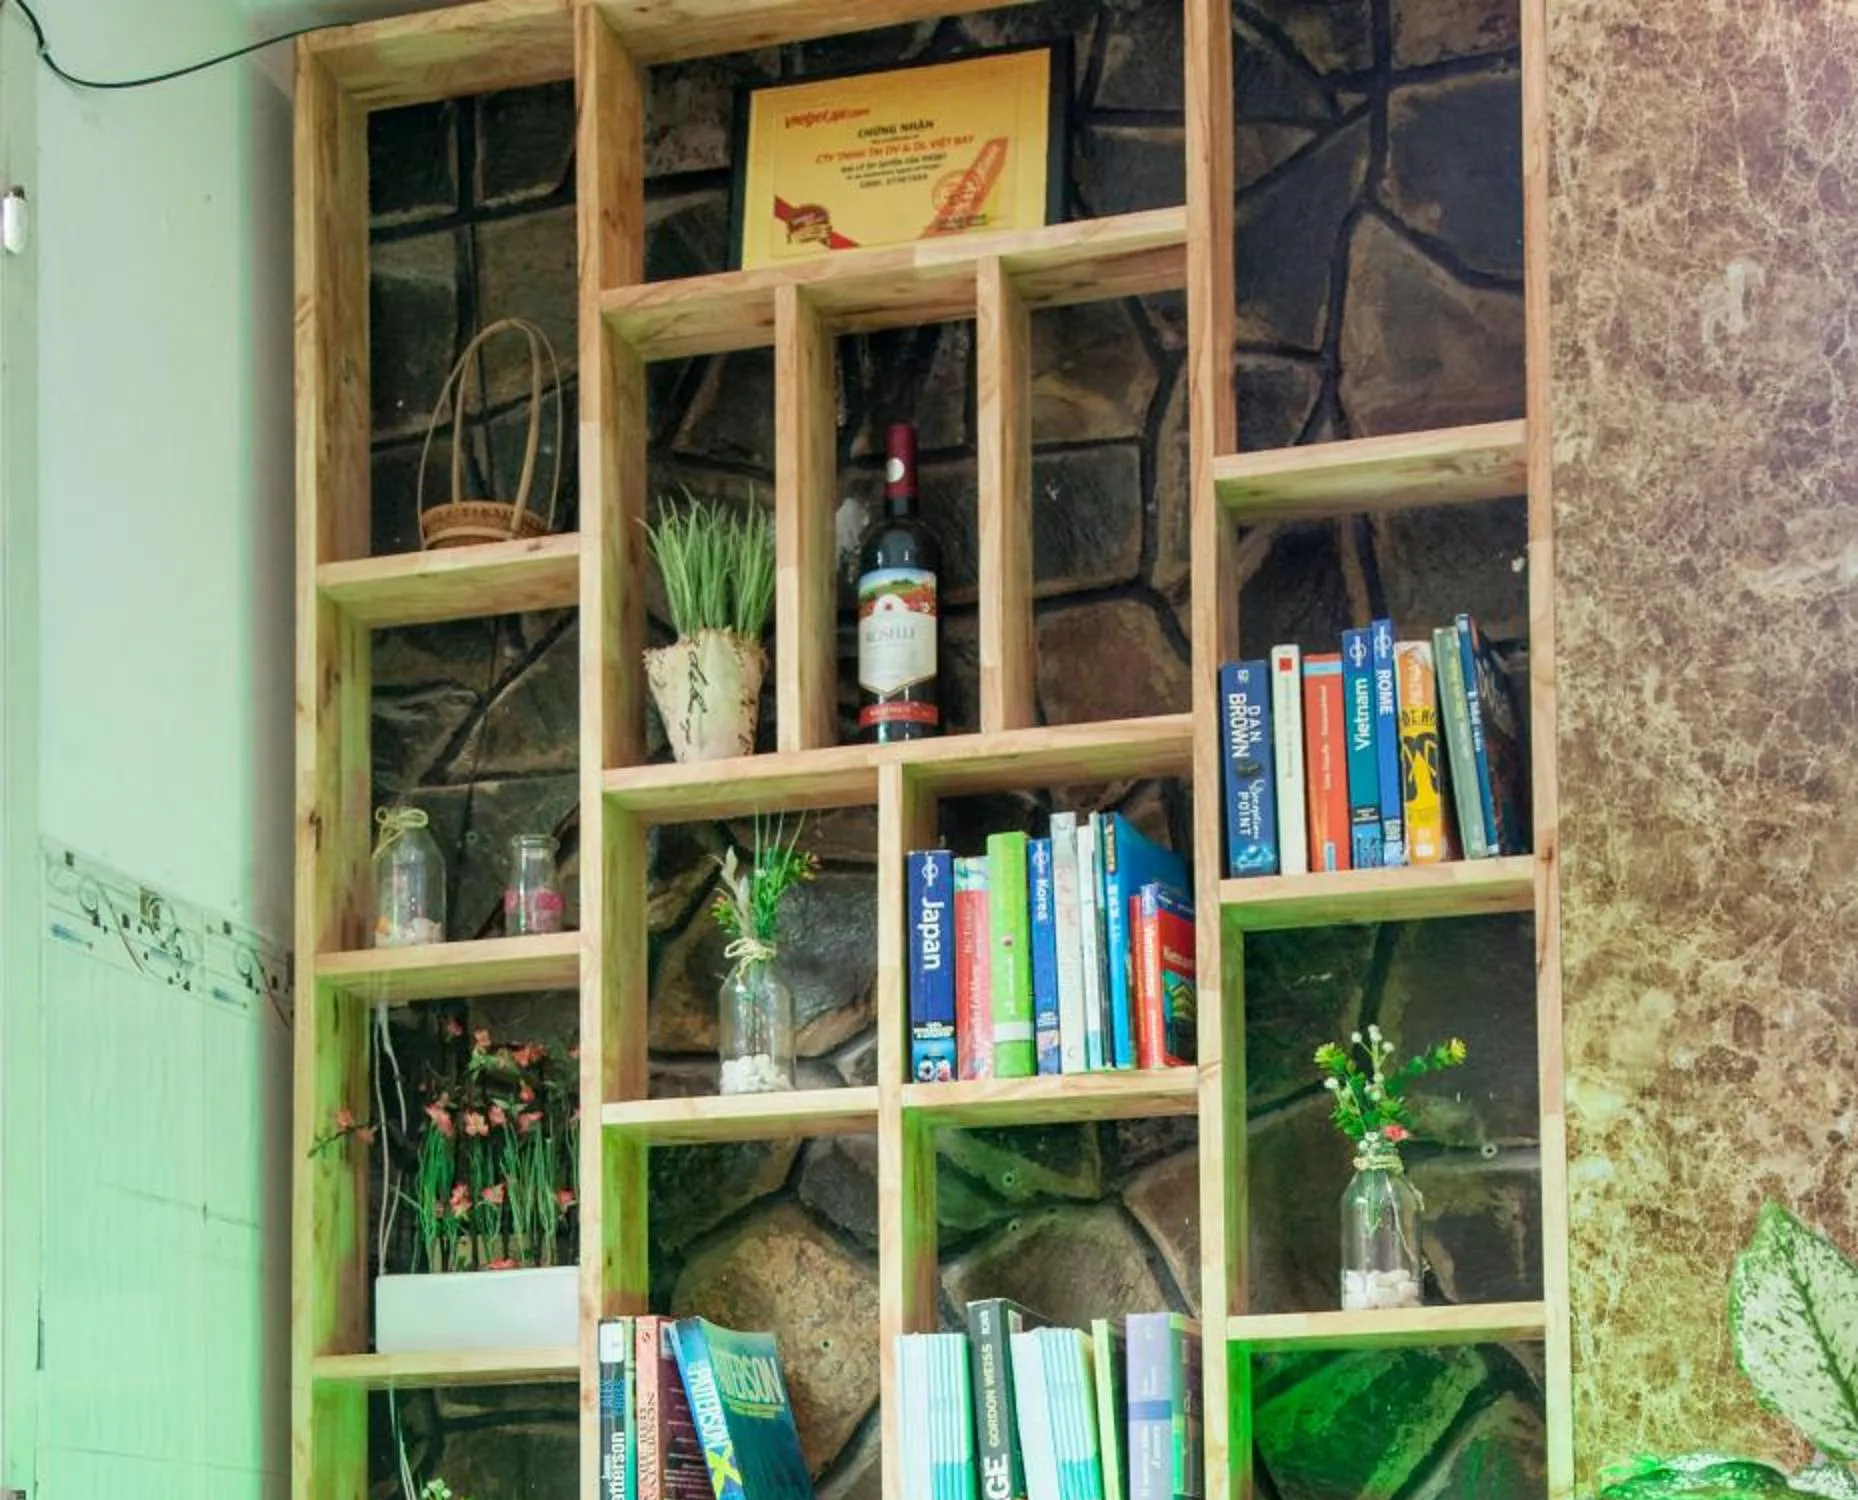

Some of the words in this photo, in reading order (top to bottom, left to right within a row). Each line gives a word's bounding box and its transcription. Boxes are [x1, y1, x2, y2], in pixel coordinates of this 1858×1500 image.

[1355, 678, 1371, 752] Vietnam
[1376, 669, 1393, 716] ROME
[1228, 693, 1249, 758] BROWN
[1248, 704, 1262, 742] DAN
[1237, 791, 1251, 837] POINT
[1037, 879, 1049, 922] Korea
[917, 896, 944, 970] Japan
[981, 1343, 995, 1389] WEISS
[983, 1389, 999, 1449] GORDON
